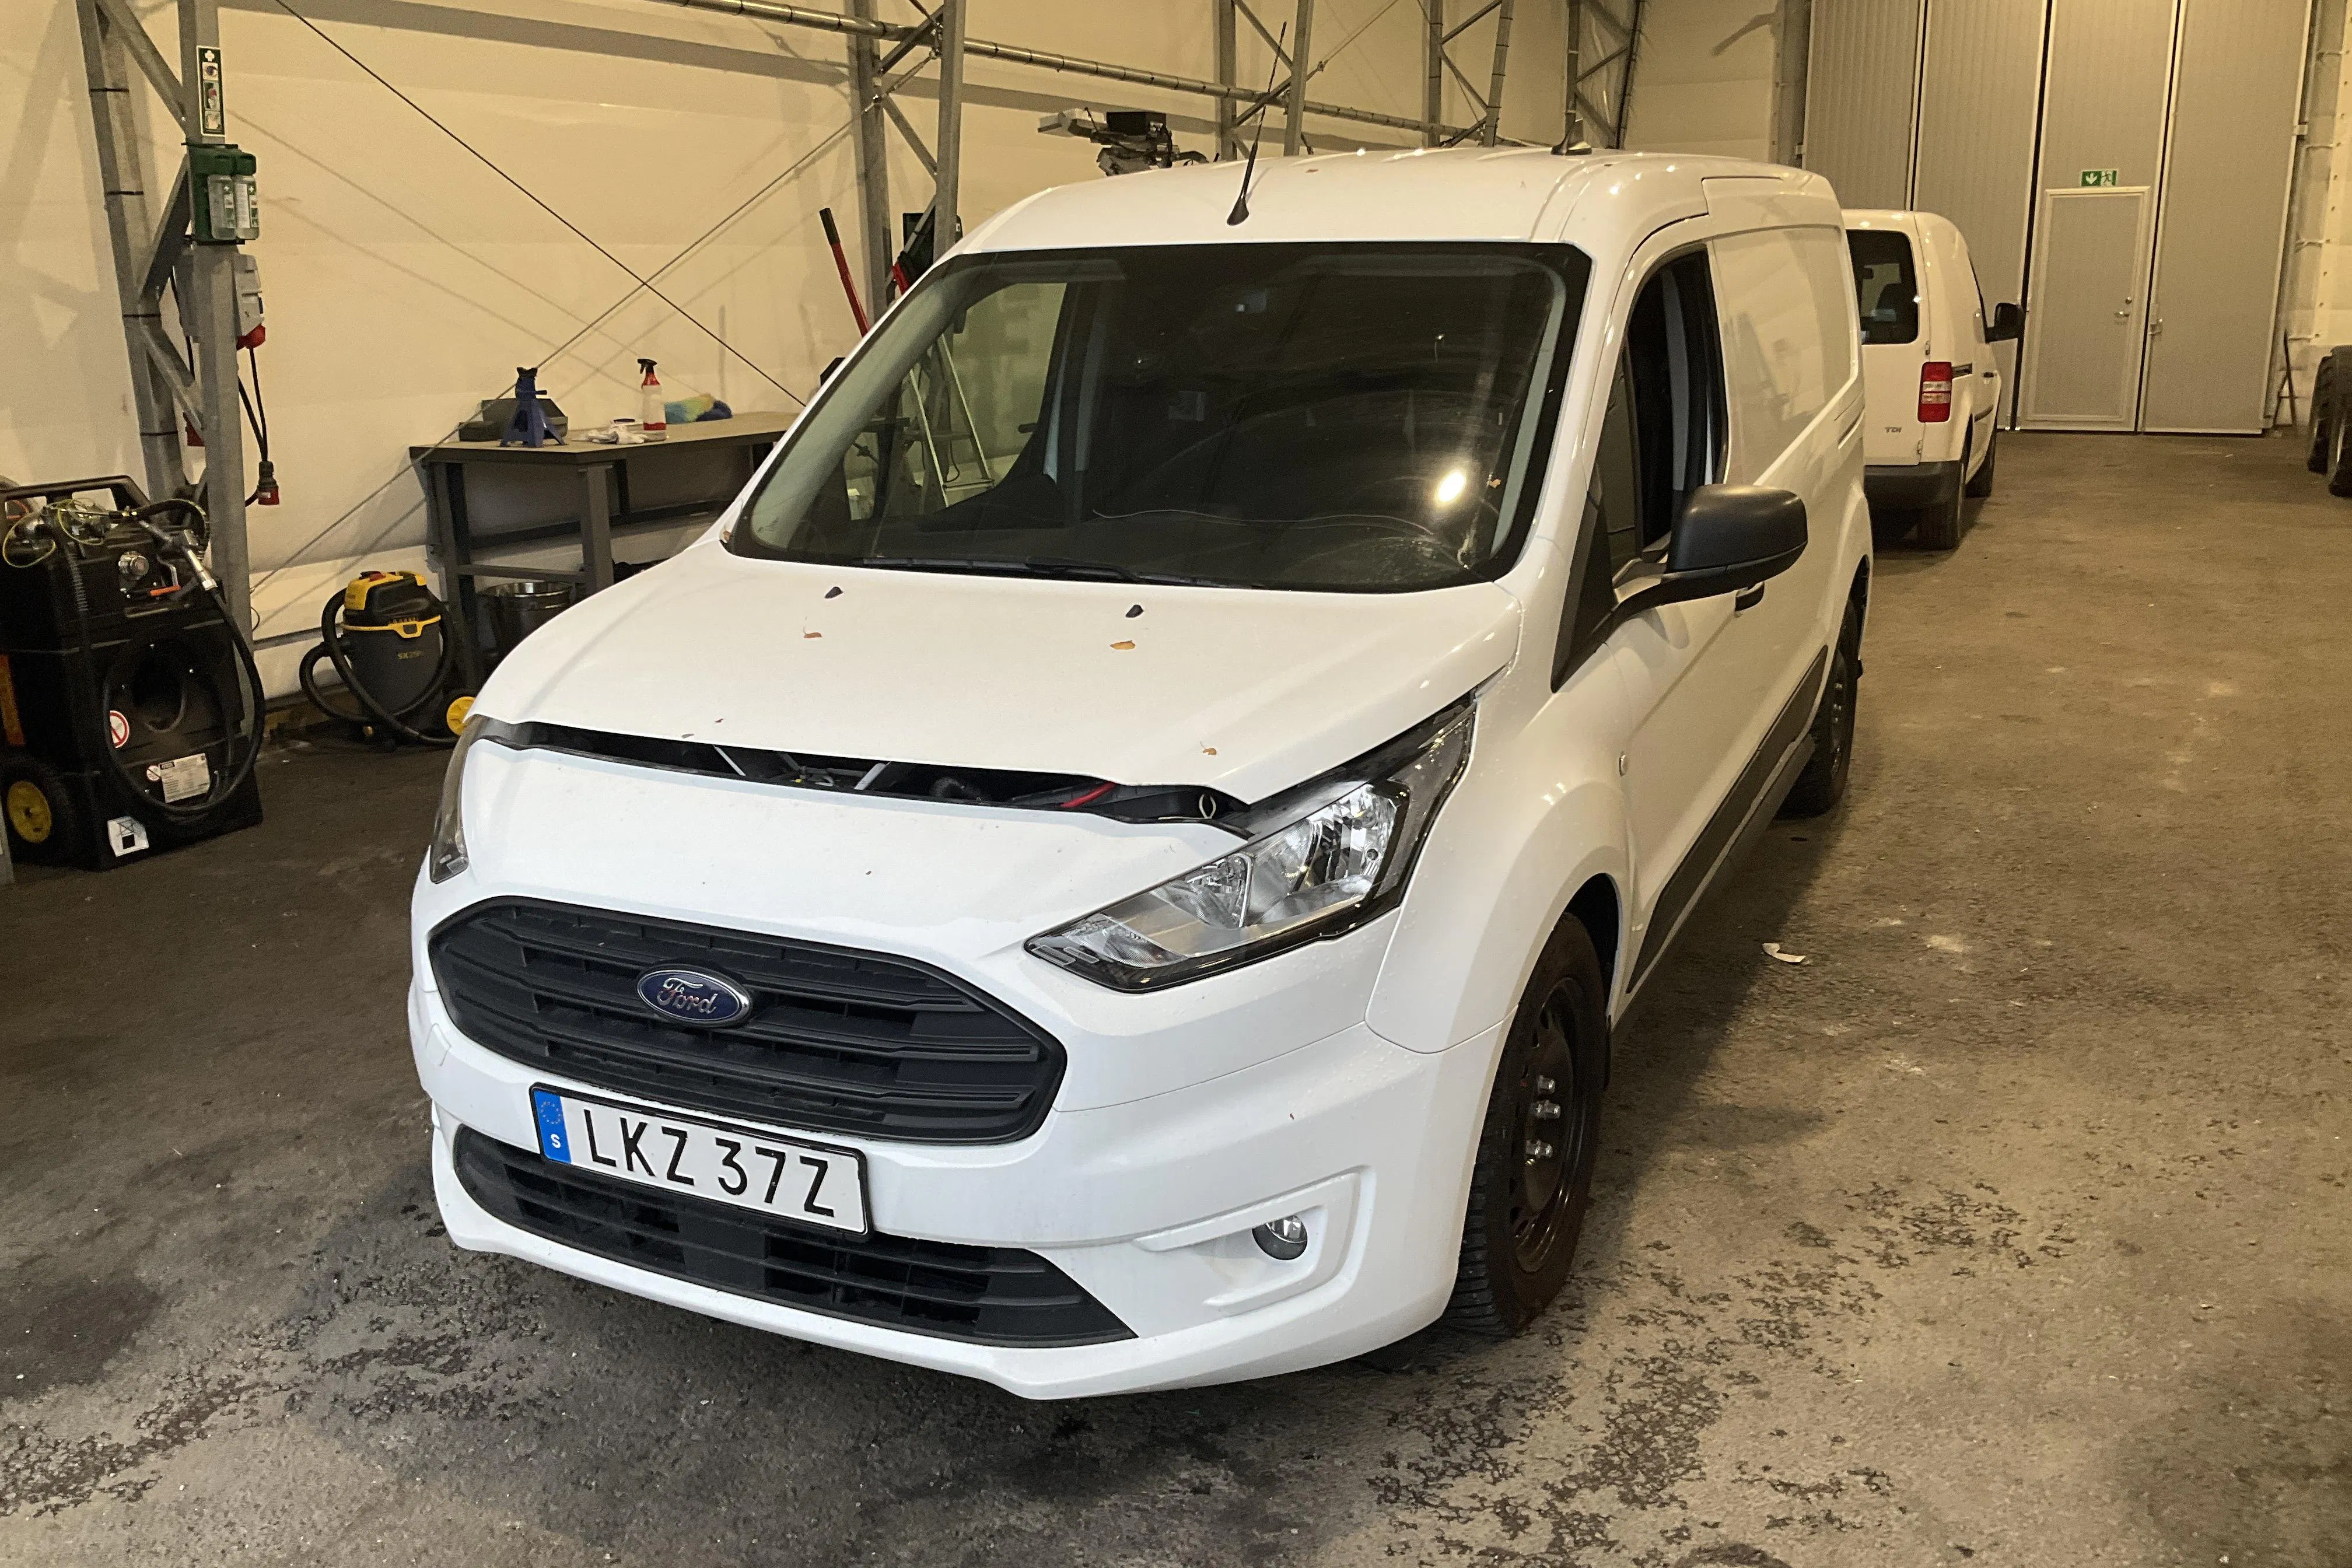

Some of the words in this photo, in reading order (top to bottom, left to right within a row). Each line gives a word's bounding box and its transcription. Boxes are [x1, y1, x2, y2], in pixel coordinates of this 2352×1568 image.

[657, 977, 718, 1014] Ford
[550, 1133, 561, 1149] S
[583, 1109, 695, 1186] LKZ
[715, 1137, 835, 1218] 37Z
